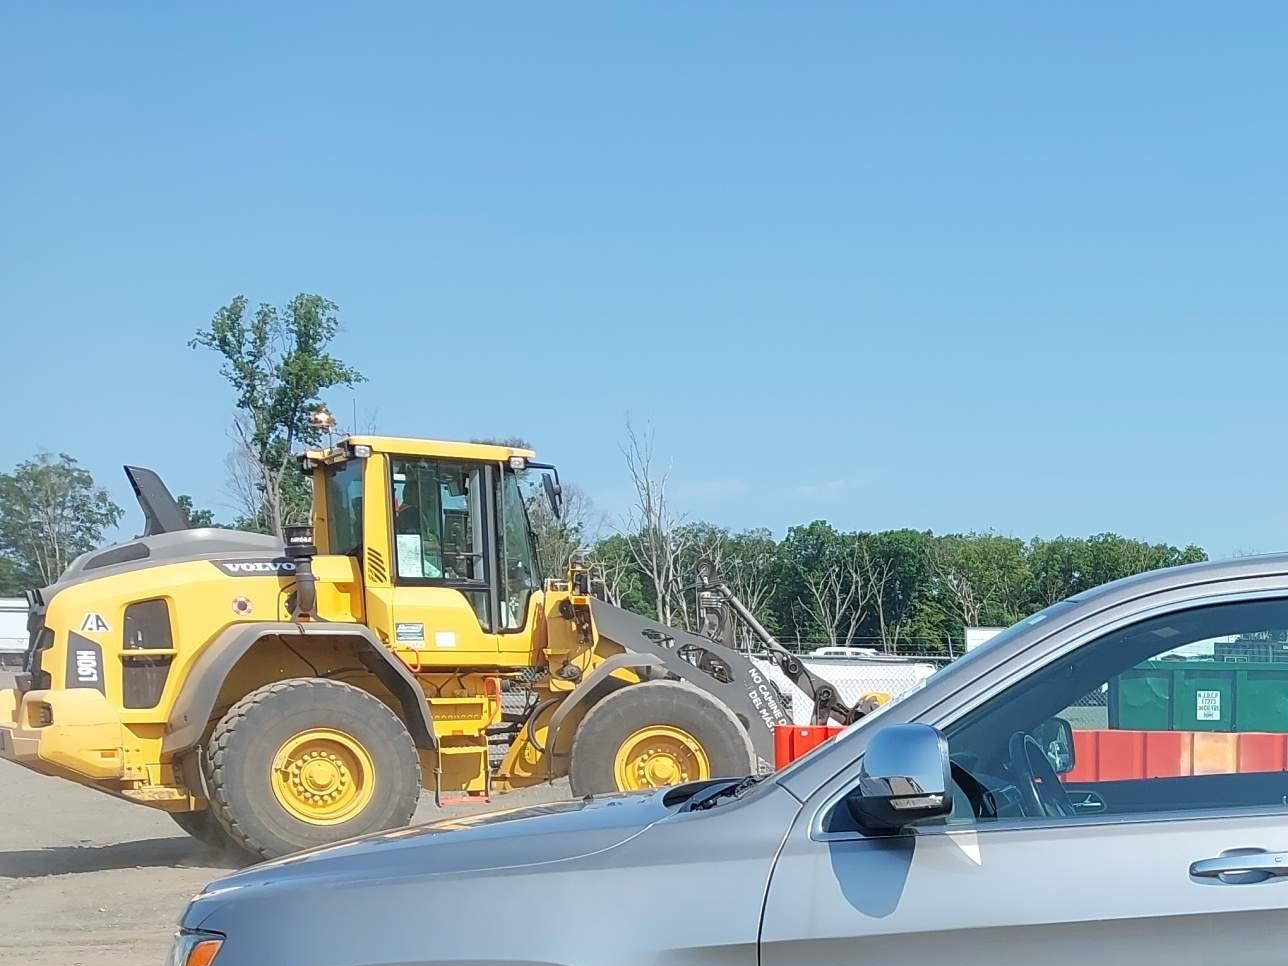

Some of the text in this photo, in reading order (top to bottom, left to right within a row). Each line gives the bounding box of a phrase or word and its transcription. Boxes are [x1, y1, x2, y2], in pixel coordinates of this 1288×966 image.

[223, 562, 297, 572] VOLVO
[76, 650, 98, 682] L90H
[749, 668, 762, 684] NO
[759, 685, 783, 719] CAMINE
[749, 690, 762, 709] DEL
